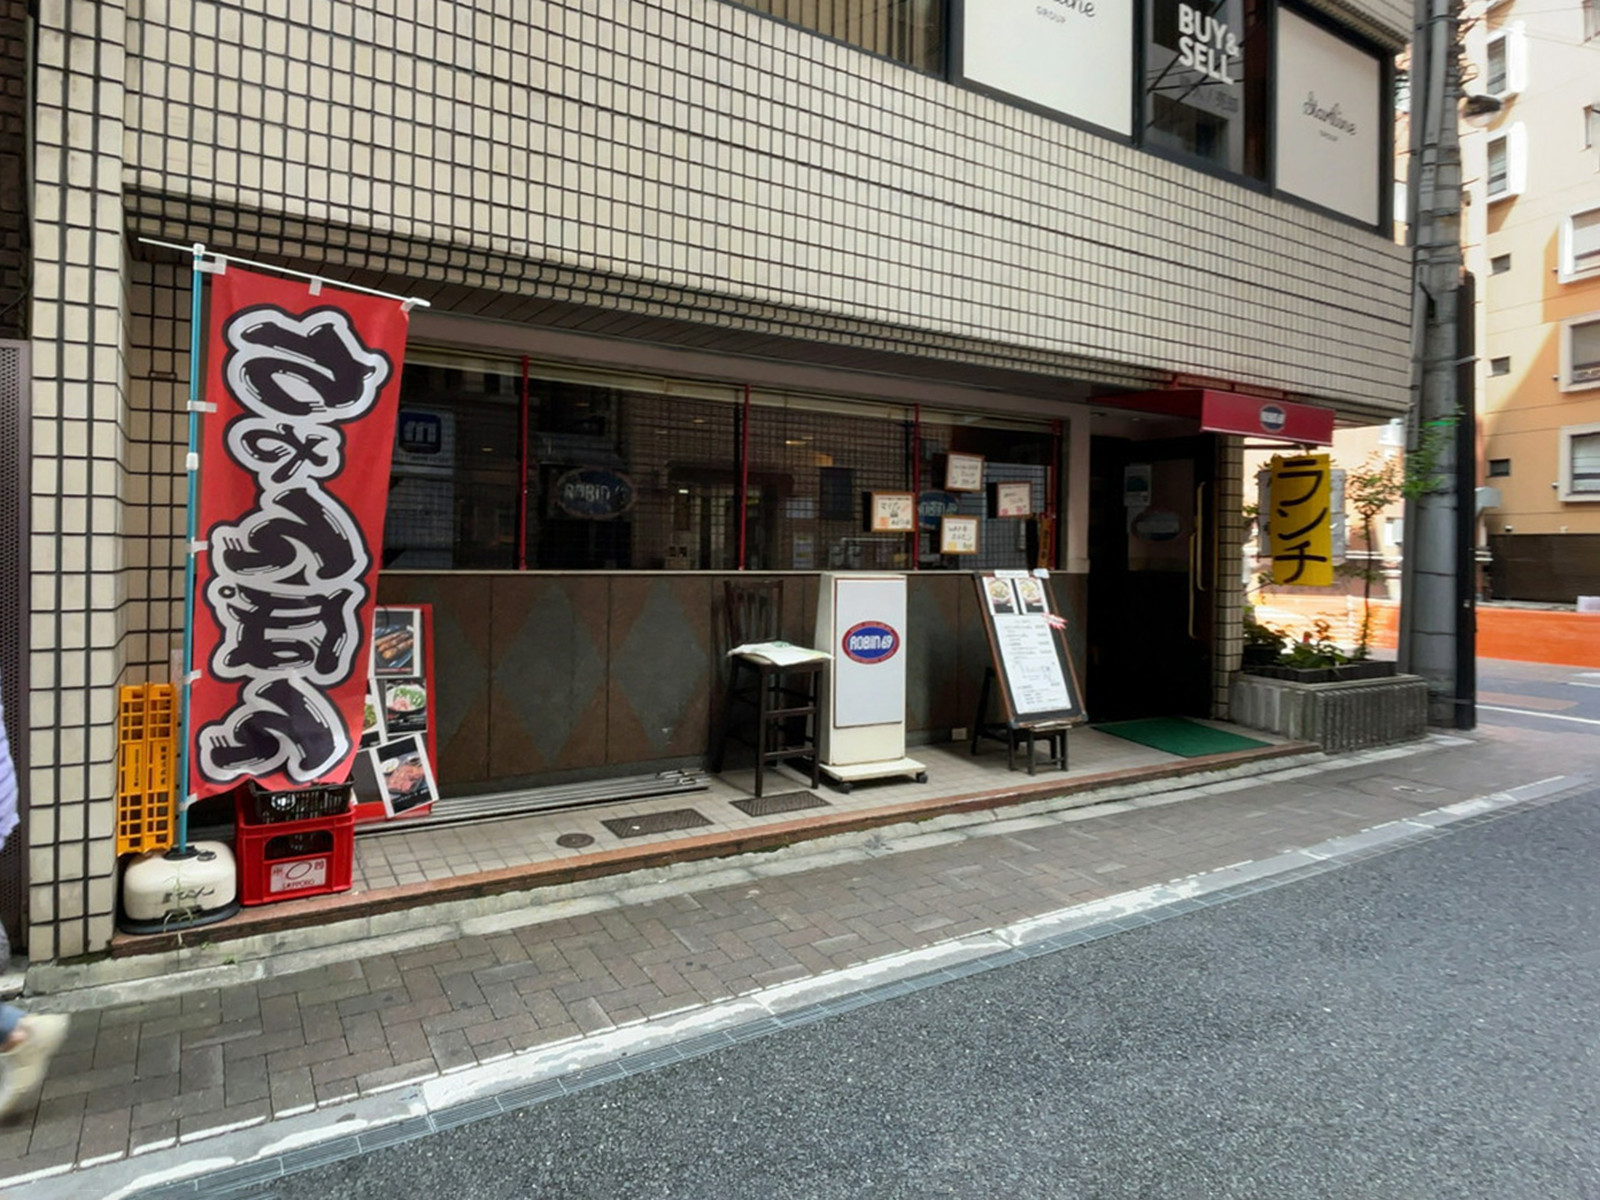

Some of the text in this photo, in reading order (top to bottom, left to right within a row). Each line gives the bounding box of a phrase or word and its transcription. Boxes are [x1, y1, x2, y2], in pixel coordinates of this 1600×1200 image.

[1178, 36, 1235, 85] SELL
[1274, 458, 1328, 584] ランチ
